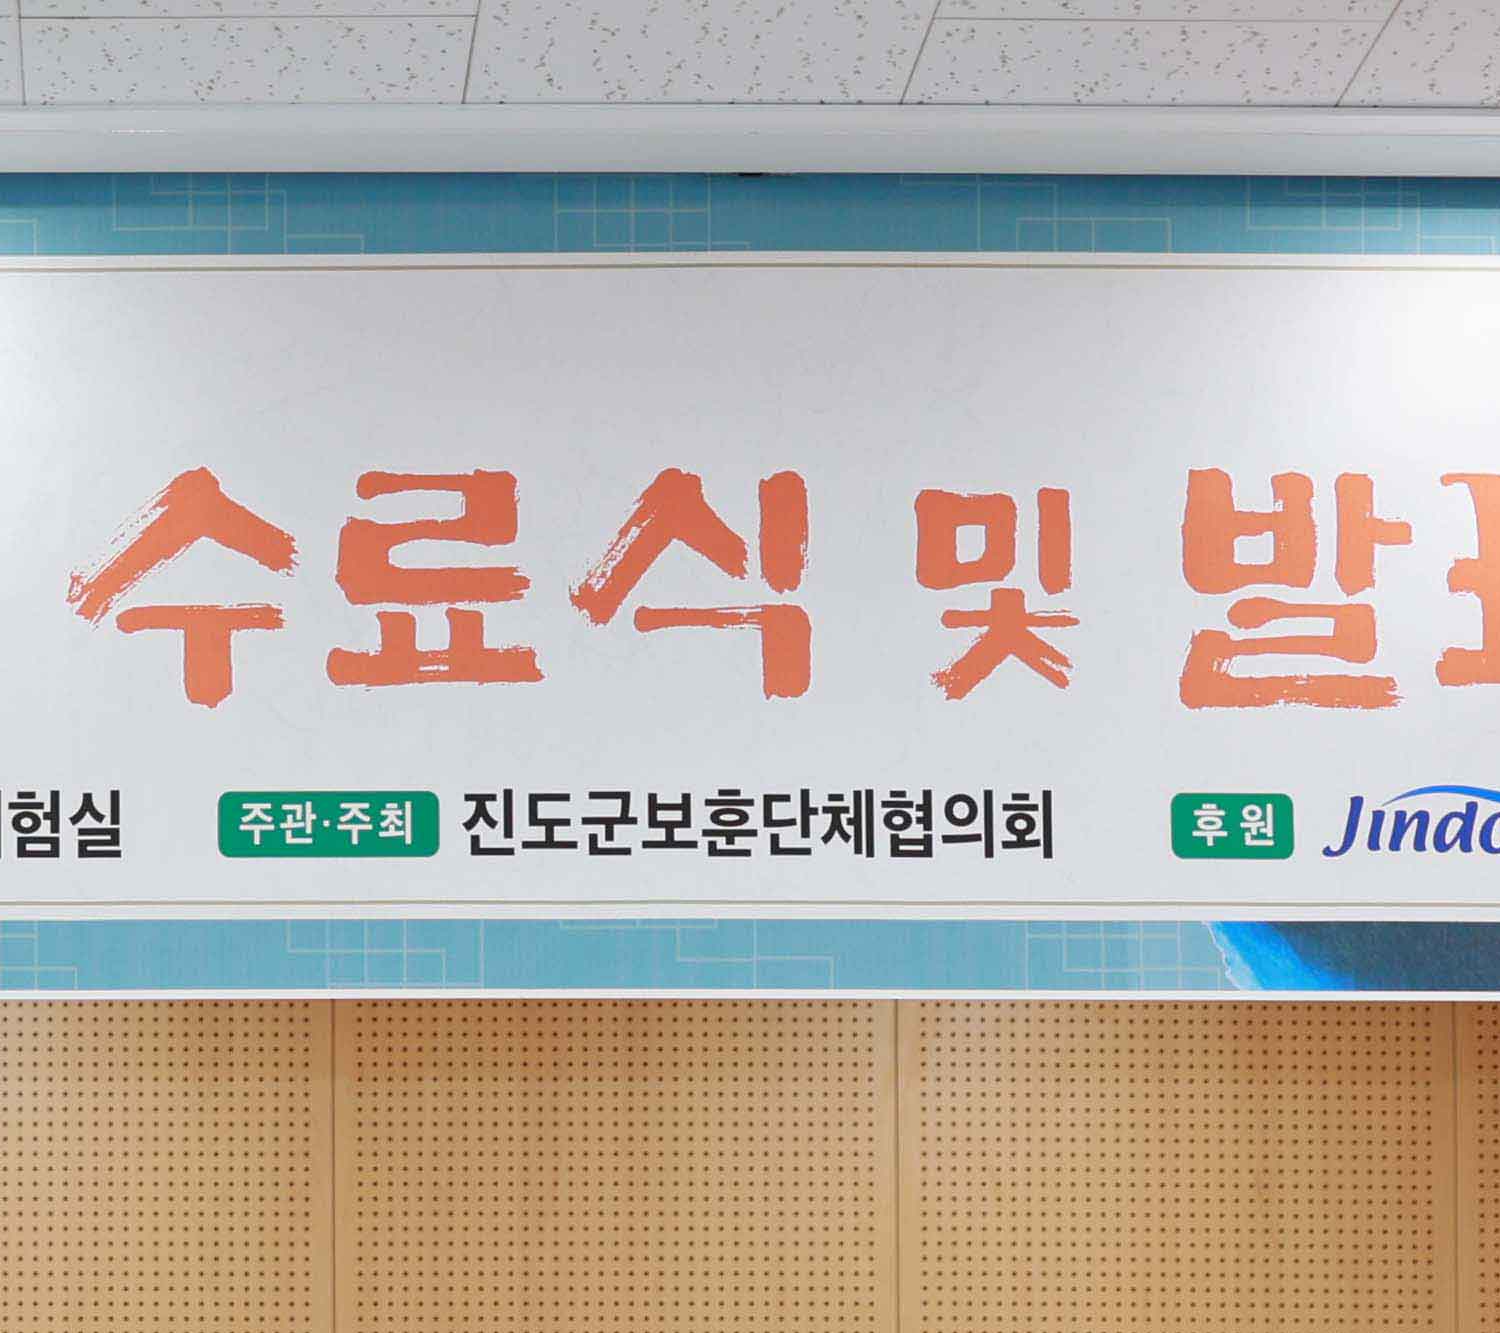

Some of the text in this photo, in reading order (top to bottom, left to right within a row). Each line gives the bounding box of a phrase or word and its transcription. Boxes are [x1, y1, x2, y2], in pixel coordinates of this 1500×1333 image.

[66, 467, 812, 708] 수료식
[914, 487, 1080, 700] 및
[239, 789, 1052, 858] 주관·주최 진도군보훈단체협의회
